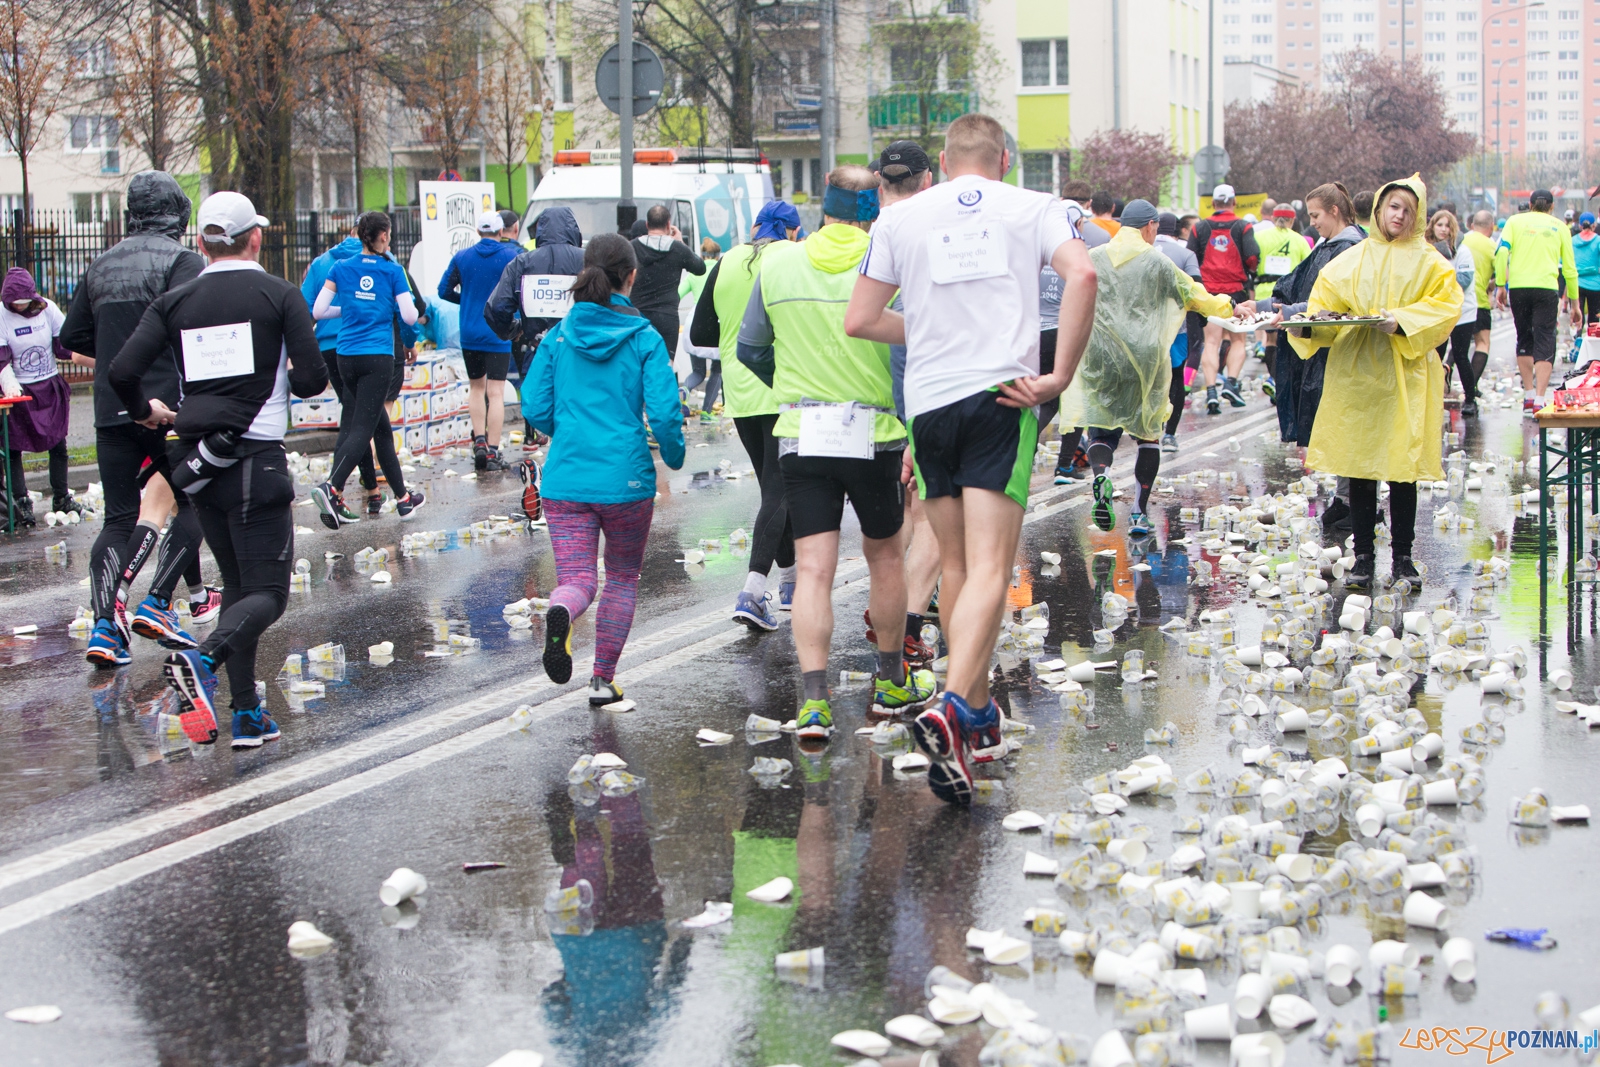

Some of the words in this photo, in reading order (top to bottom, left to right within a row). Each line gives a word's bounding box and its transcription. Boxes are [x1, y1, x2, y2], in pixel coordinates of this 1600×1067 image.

[1278, 240, 1290, 256] 4
[210, 359, 228, 367] Kuby
[825, 438, 842, 446] Kuby
